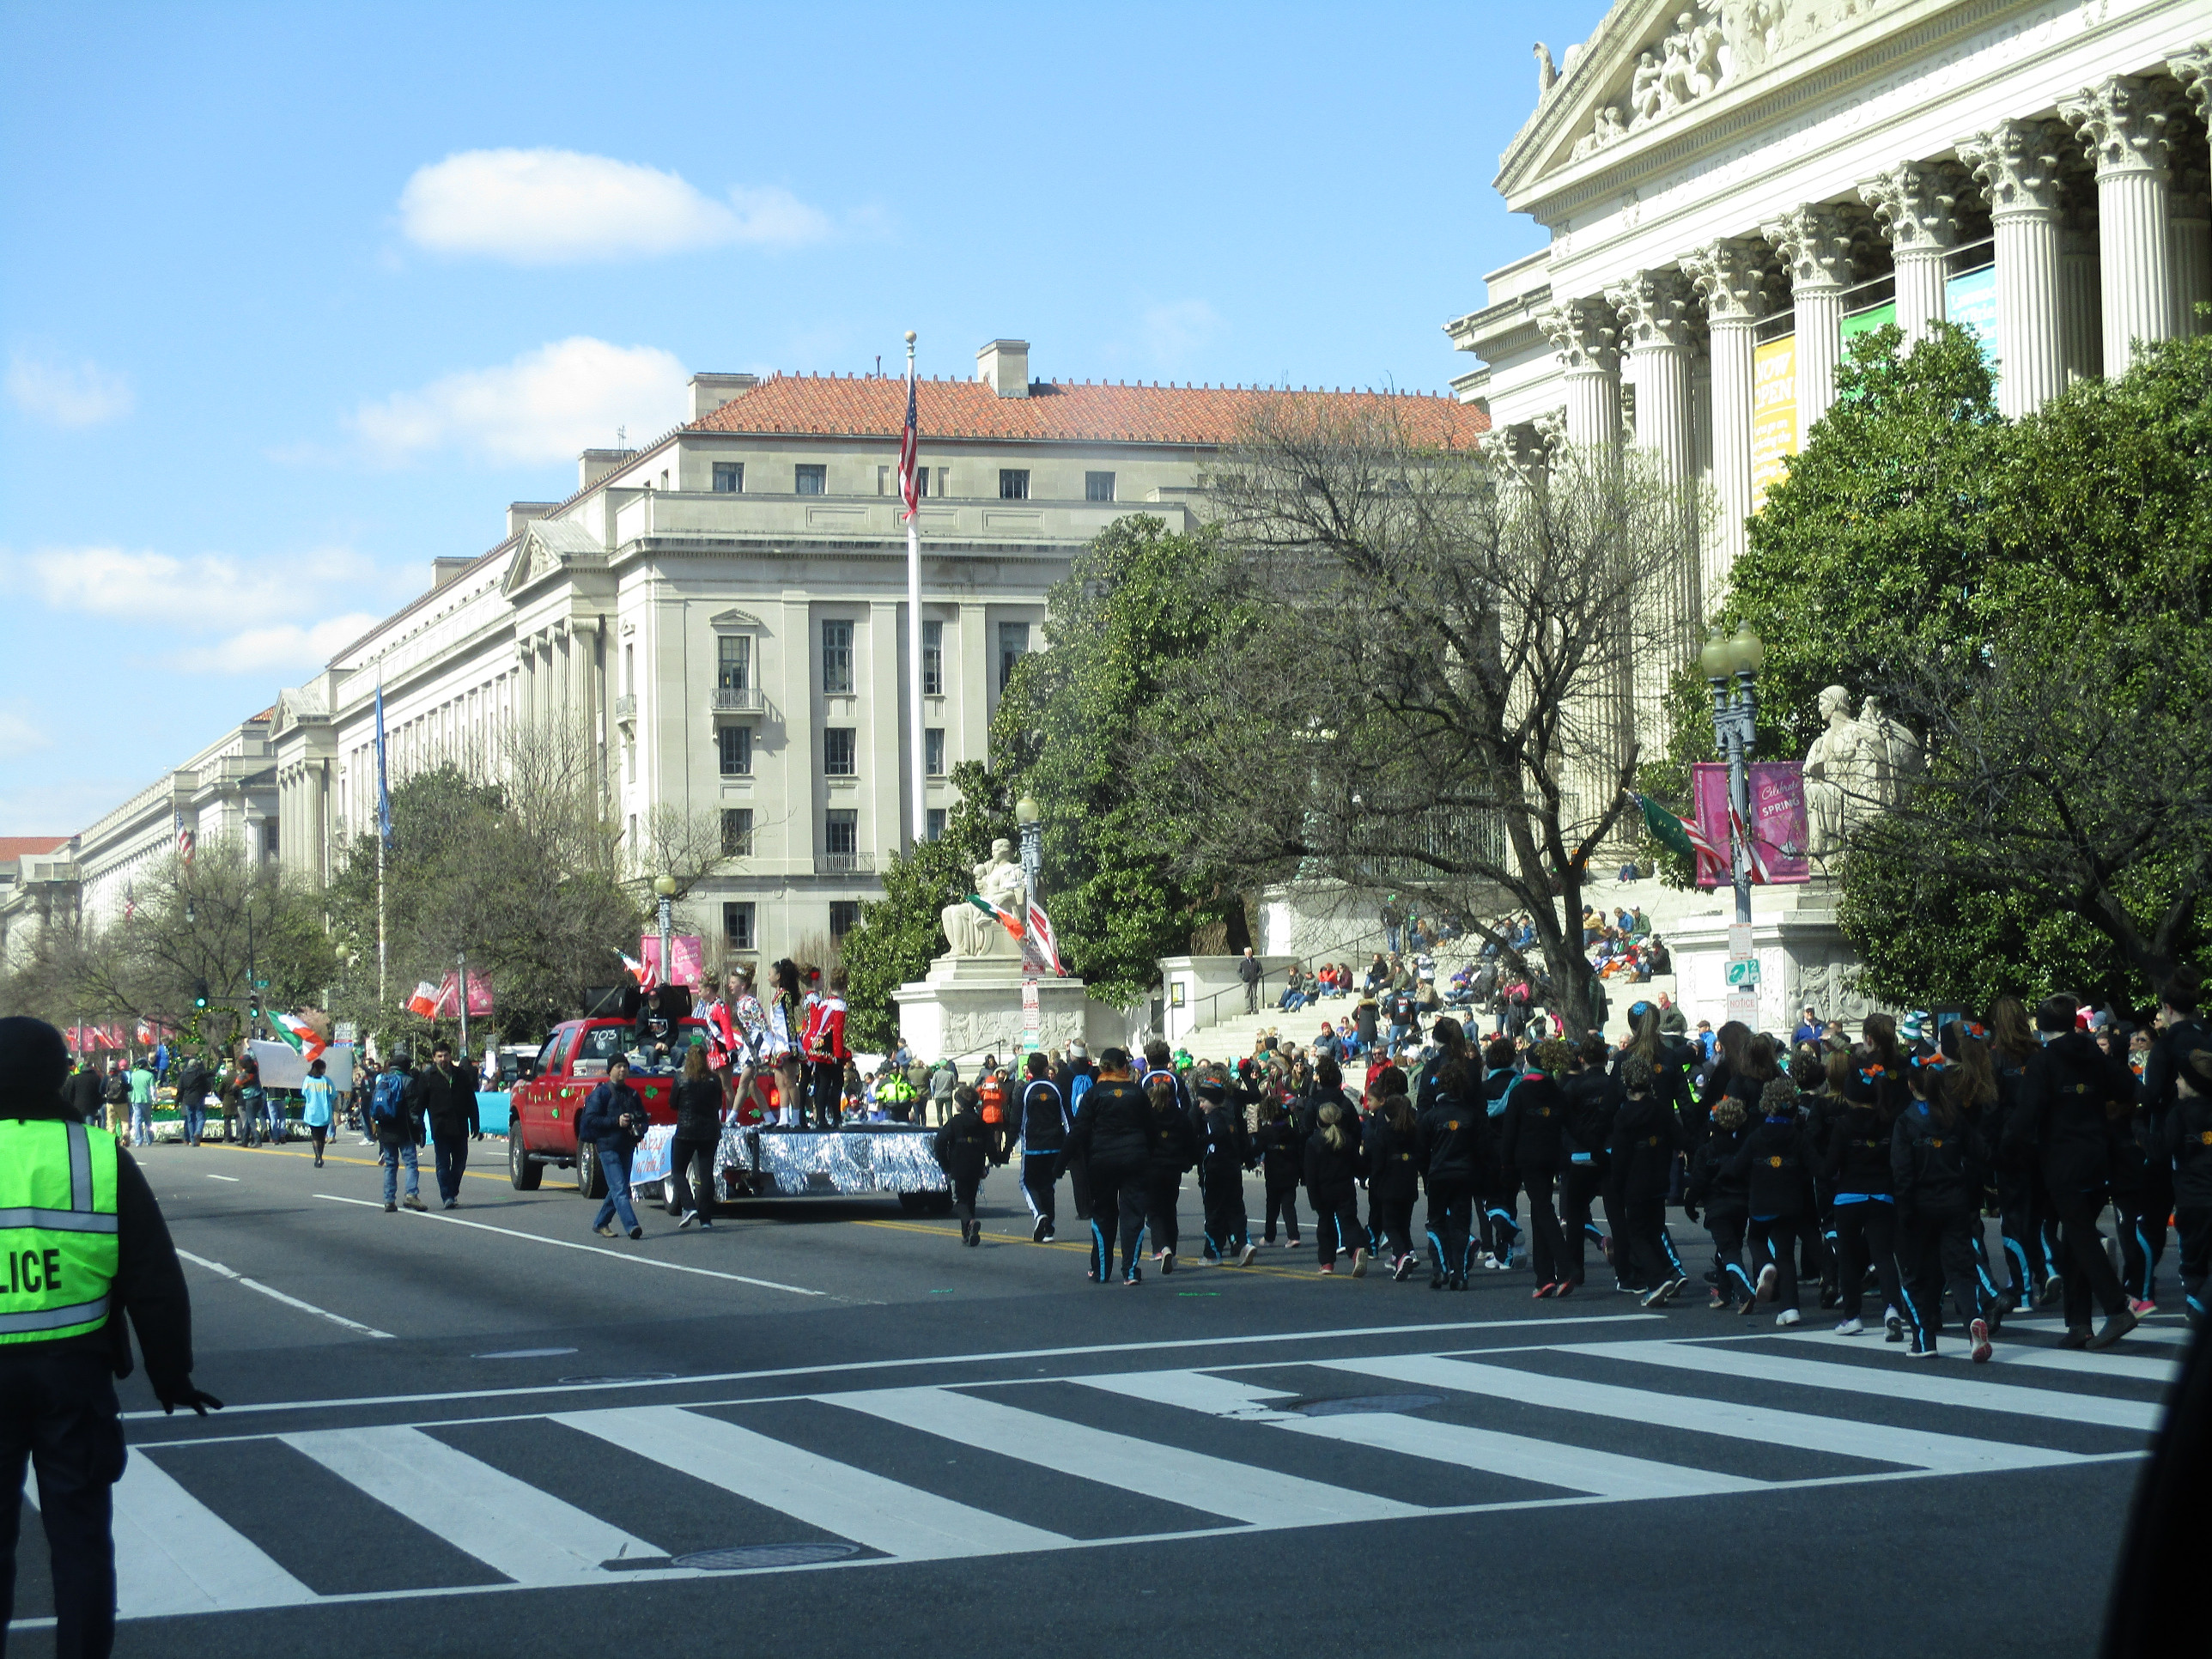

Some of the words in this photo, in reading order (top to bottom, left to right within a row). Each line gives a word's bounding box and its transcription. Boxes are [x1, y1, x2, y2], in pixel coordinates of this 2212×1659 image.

[1656, 155, 1731, 211] ARCHIVES
[1738, 143, 1757, 174] OF
[1761, 128, 1792, 166] THE
[1798, 99, 1862, 146] UNITED
[1869, 64, 1929, 116] STATES
[1937, 52, 1960, 85] OF
[1966, 6, 2061, 76] AMERICA
[1755, 351, 1792, 385] NOW
[1761, 780, 1802, 800] Celebrate
[1762, 797, 1801, 817] SPRING
[1729, 998, 1755, 1008] NOTICE
[591, 1030, 617, 1042] 703
